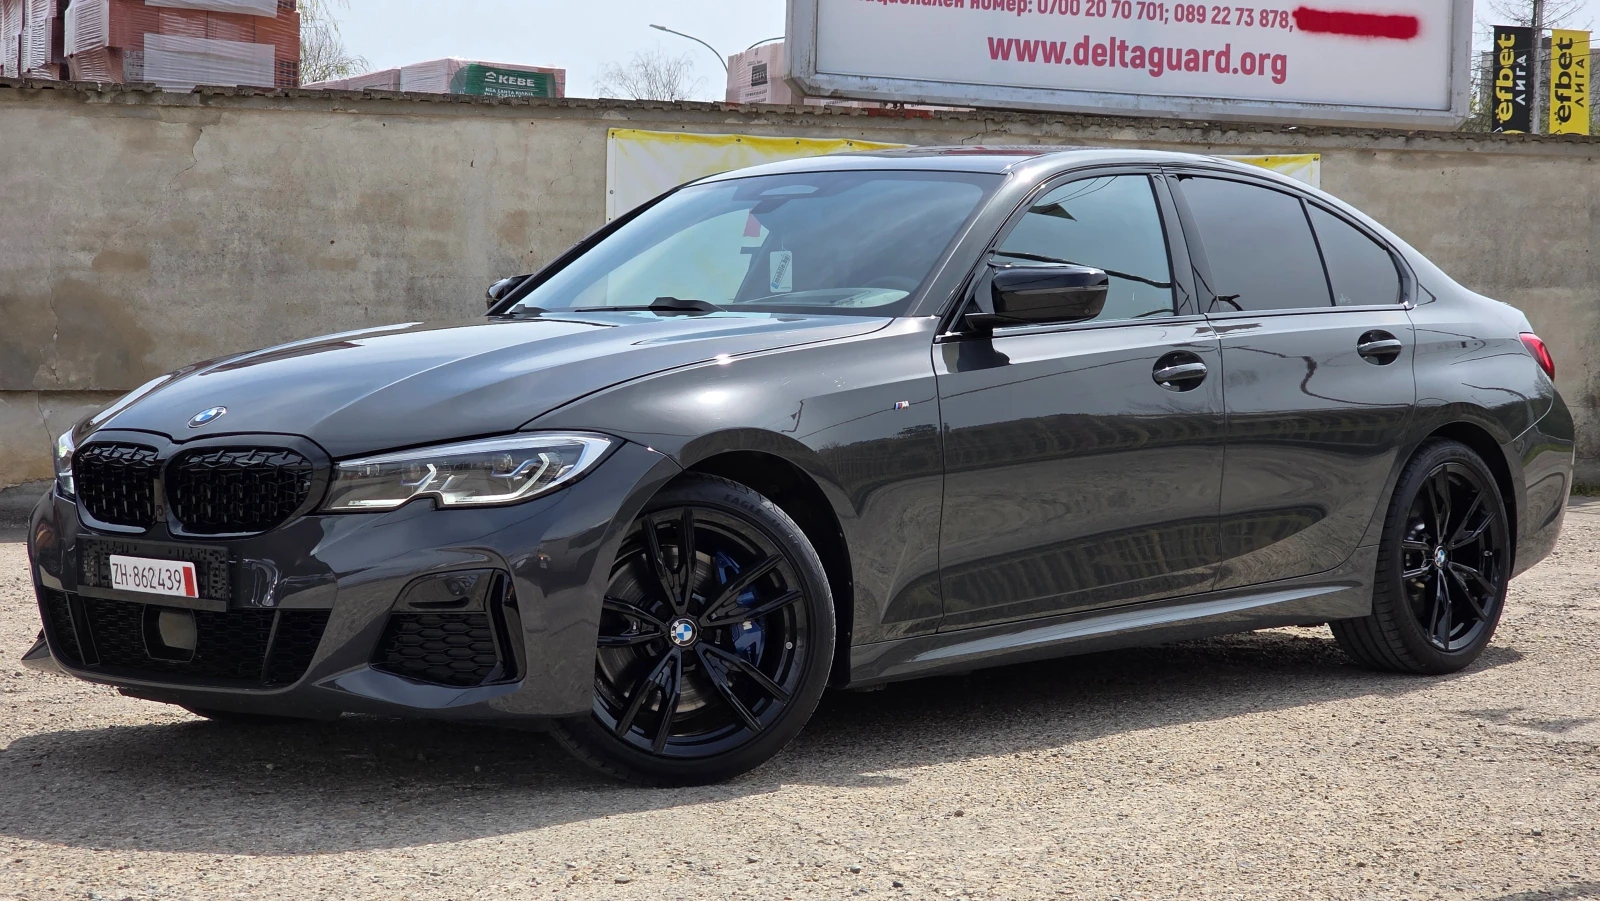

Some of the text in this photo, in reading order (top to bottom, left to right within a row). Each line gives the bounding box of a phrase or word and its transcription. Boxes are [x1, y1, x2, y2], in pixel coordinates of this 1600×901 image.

[1037, 0, 1080, 16] 0700
[1085, 0, 1106, 17] 20
[1111, 1, 1132, 19] 70
[1136, 2, 1169, 25] 701;
[1174, 5, 1207, 24] 089
[1211, 6, 1231, 25] 22
[1235, 8, 1254, 27] 73
[1259, 9, 1293, 32] 878,
[987, 35, 1287, 85] www.deltaguard.org
[1496, 33, 1515, 122] efbet
[1555, 37, 1573, 123] efbet
